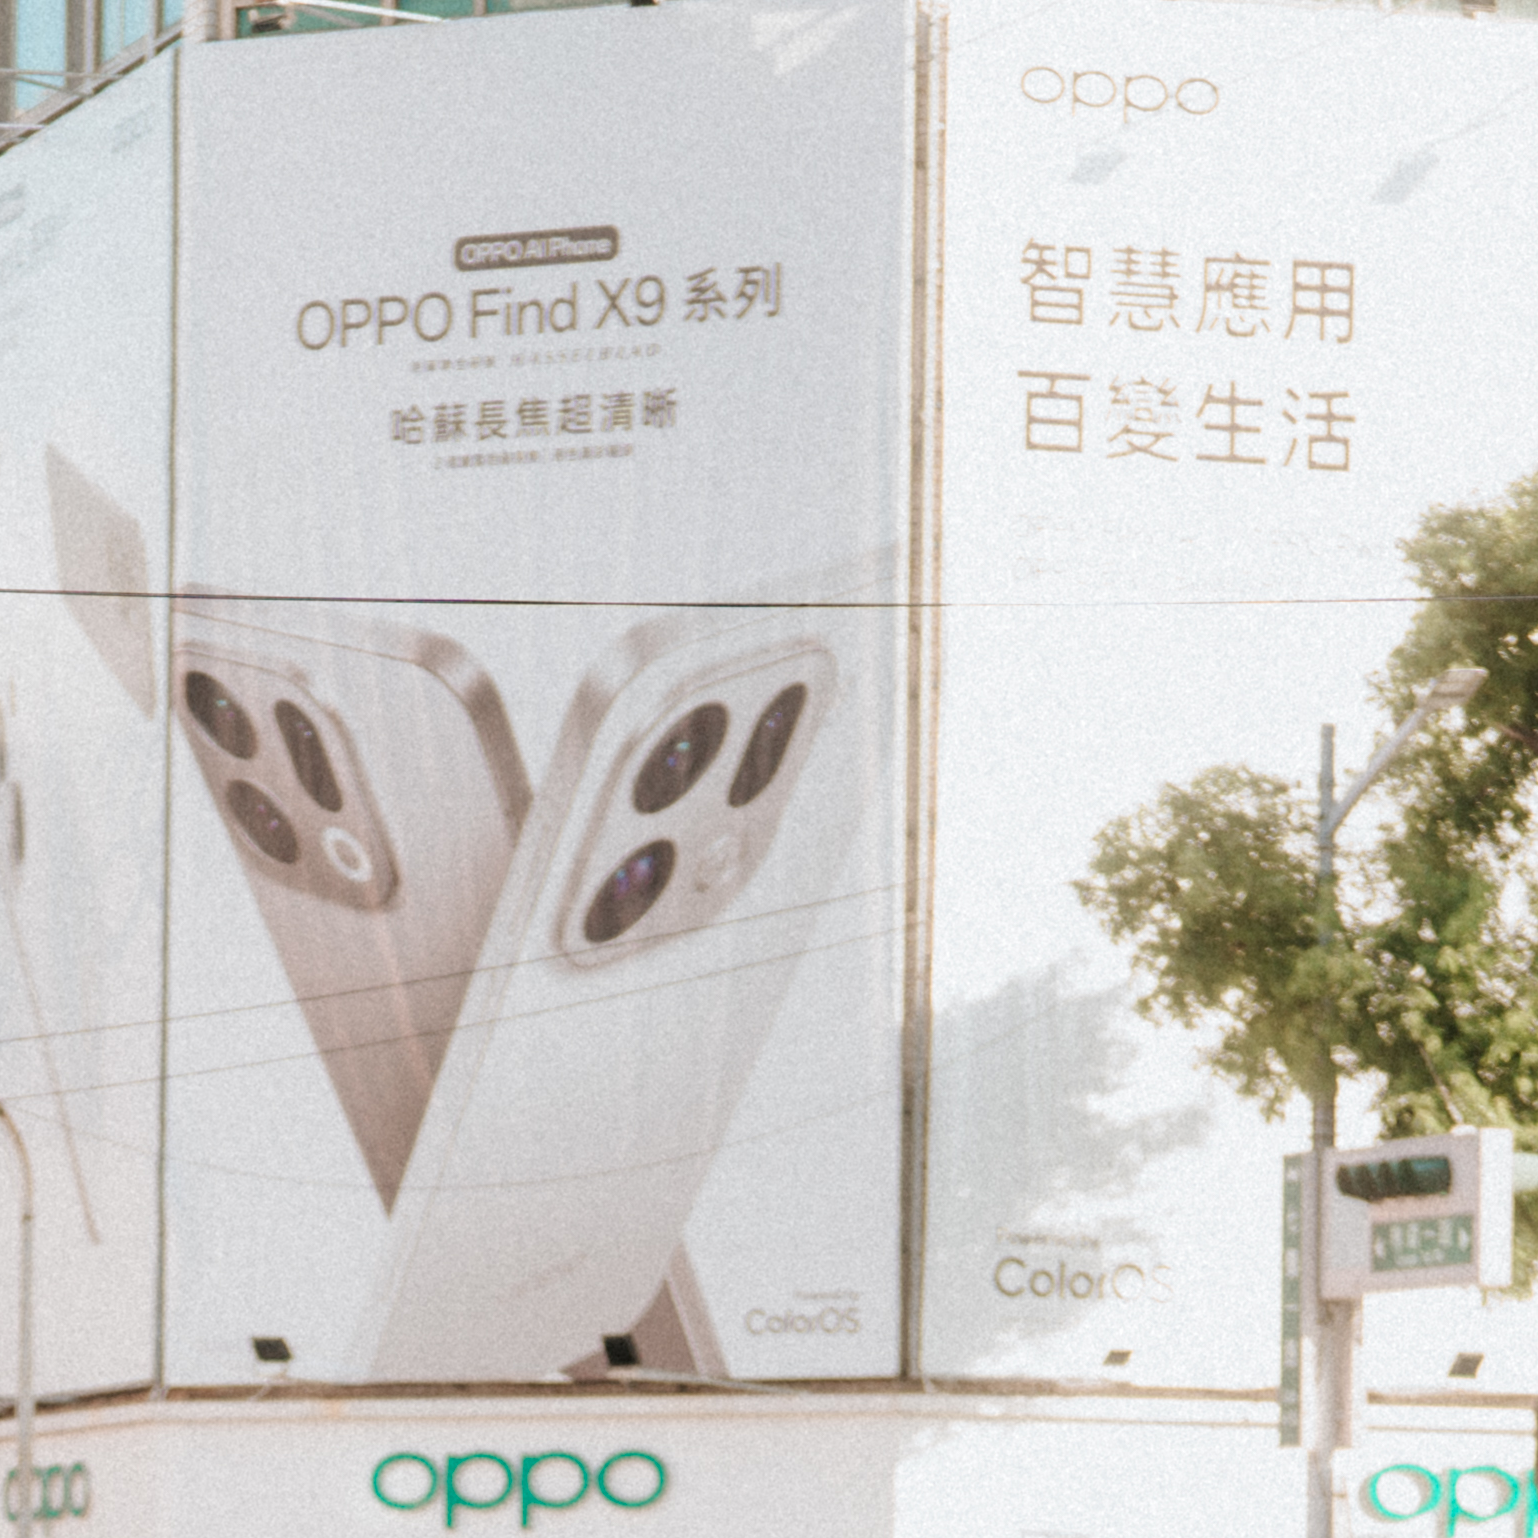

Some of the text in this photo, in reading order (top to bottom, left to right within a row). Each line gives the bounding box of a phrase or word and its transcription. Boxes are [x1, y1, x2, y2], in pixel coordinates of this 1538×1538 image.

[1021, 66, 1220, 124] oppo
[460, 236, 613, 264] OPPO AI Phone
[297, 262, 783, 351] OPPO Find X9 系列
[1019, 238, 1355, 344] 智慧應用
[392, 387, 677, 445] 哈蘇長焦超清晰
[1017, 370, 1357, 471] 百變生活
[993, 1256, 1176, 1303] ColorOS
[744, 1306, 862, 1336] ColorOS
[372, 1451, 667, 1529] oppo
